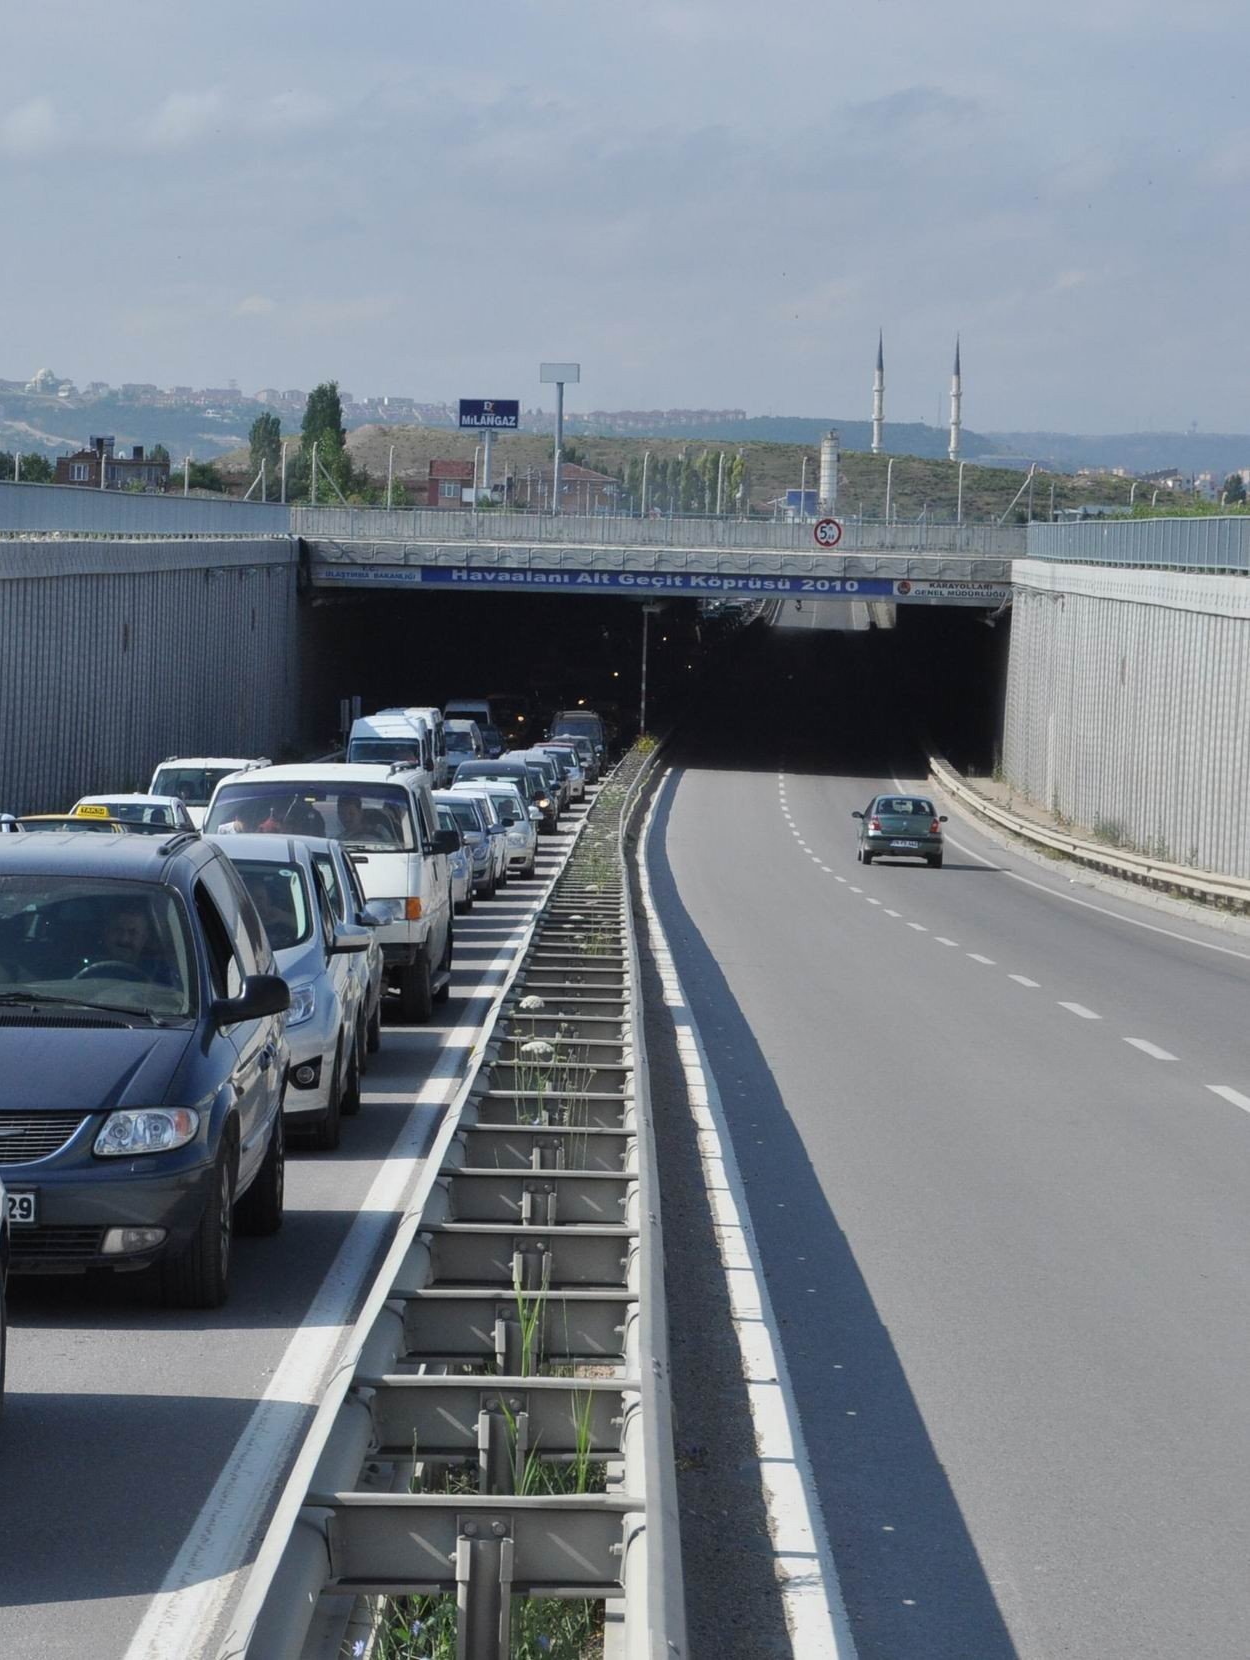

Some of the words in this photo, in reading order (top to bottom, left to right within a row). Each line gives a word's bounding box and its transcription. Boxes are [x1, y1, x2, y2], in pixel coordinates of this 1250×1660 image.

[452, 569, 570, 583] Havaalanı
[576, 571, 610, 585] Alt
[618, 573, 683, 588] Geçit
[690, 575, 791, 590] Köprüsü
[802, 579, 859, 592] 2010
[929, 582, 993, 590] KARAYOLLARI
[914, 589, 945, 597] GENEL
[947, 589, 1006, 598] MÜDÜRLÜĞÜ
